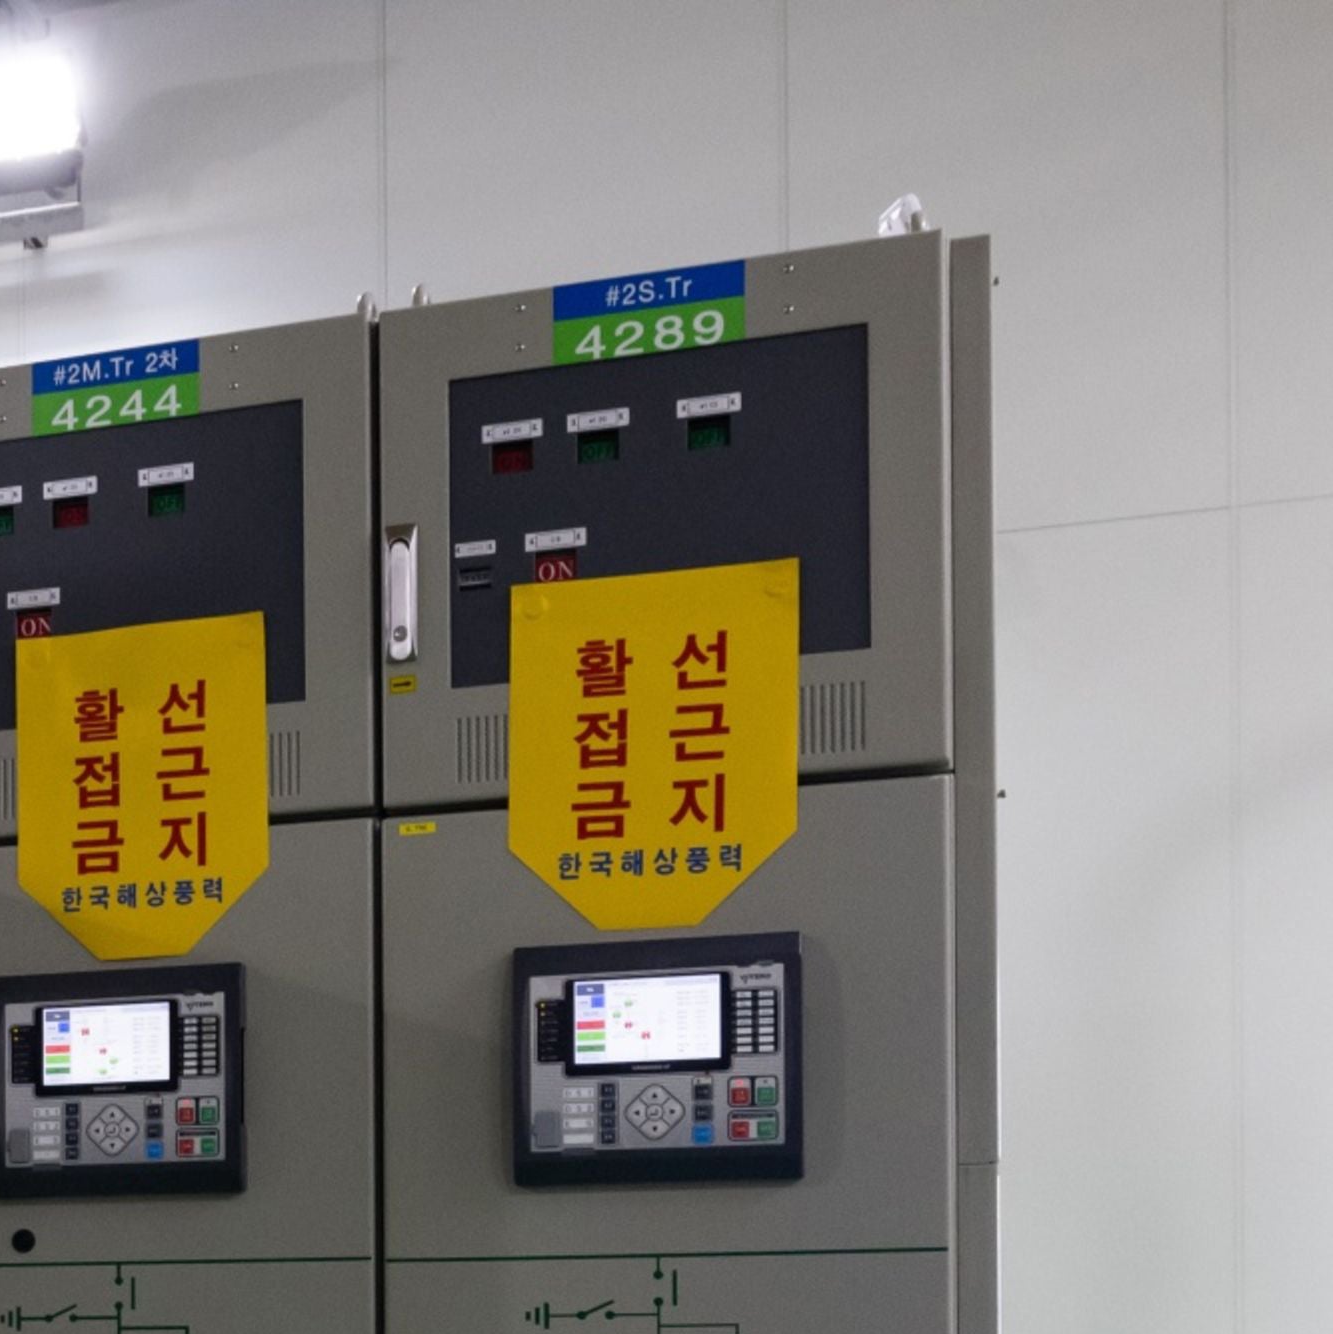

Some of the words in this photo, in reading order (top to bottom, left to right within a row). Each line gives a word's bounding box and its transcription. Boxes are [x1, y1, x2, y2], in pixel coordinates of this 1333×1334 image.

[605, 275, 692, 307] #2S.Tr
[575, 309, 725, 360] 4289
[53, 355, 134, 387] #2M.Tr
[145, 347, 178, 374] 2차
[51, 384, 182, 432] 4244
[538, 561, 573, 582] ON
[21, 617, 52, 637] ON
[557, 843, 742, 881] 한국해상풍력
[62, 879, 224, 913] 한국해상풍력
